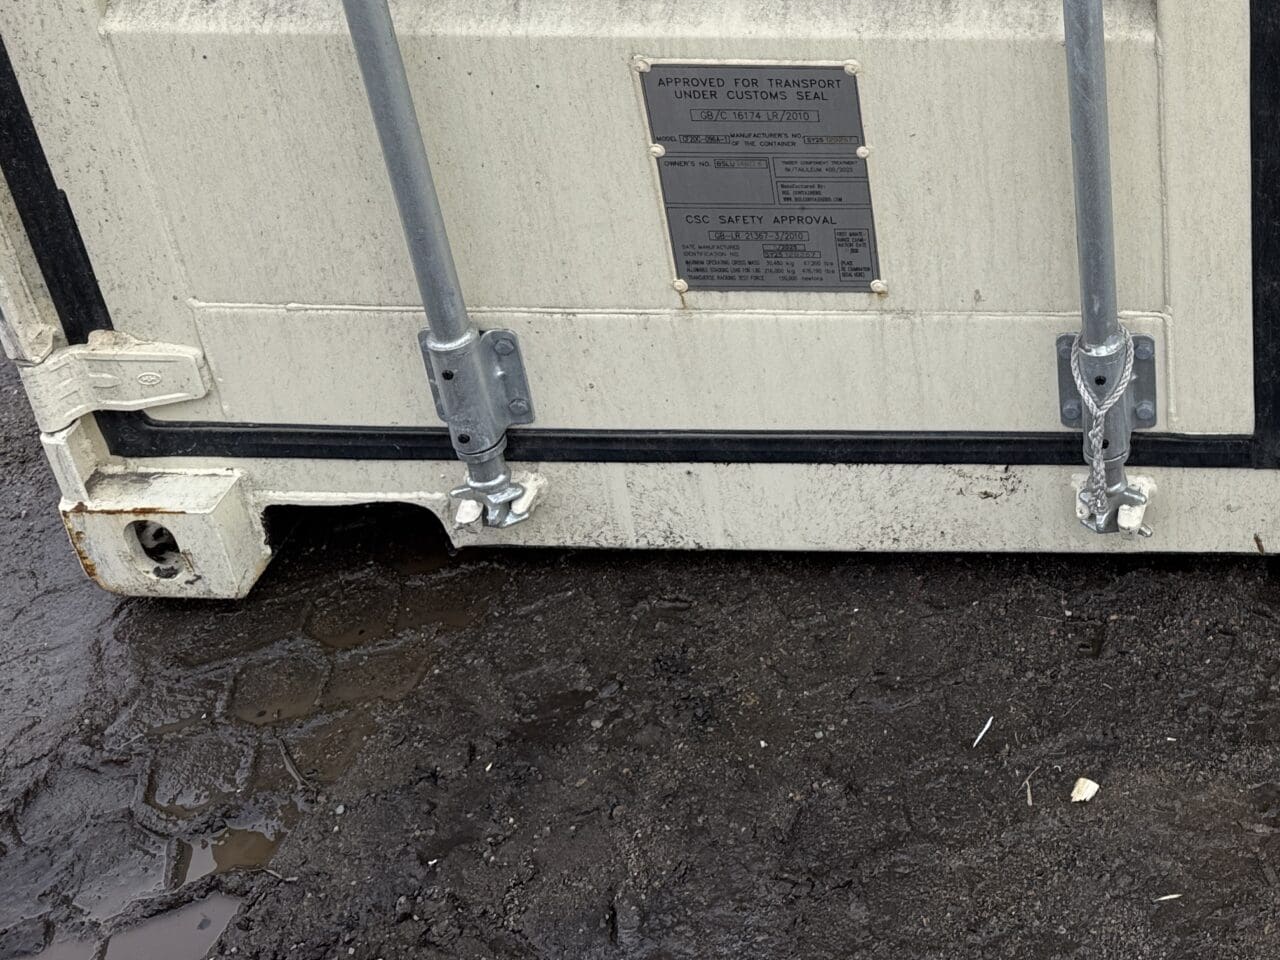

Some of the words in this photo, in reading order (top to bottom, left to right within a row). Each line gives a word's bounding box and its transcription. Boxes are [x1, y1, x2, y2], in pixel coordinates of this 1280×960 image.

[658, 78, 725, 88] APPROVED
[734, 78, 759, 88] FOR
[768, 78, 842, 89] TRANSPORT
[674, 90, 718, 100] UNDER
[727, 90, 788, 101] CUSTOMS
[796, 90, 829, 101] SEAL
[700, 109, 727, 121] GB/C
[733, 111, 761, 120] 16174
[685, 215, 710, 224] CSC
[719, 215, 763, 225] SAFETY
[773, 216, 837, 225] APPROVAL
